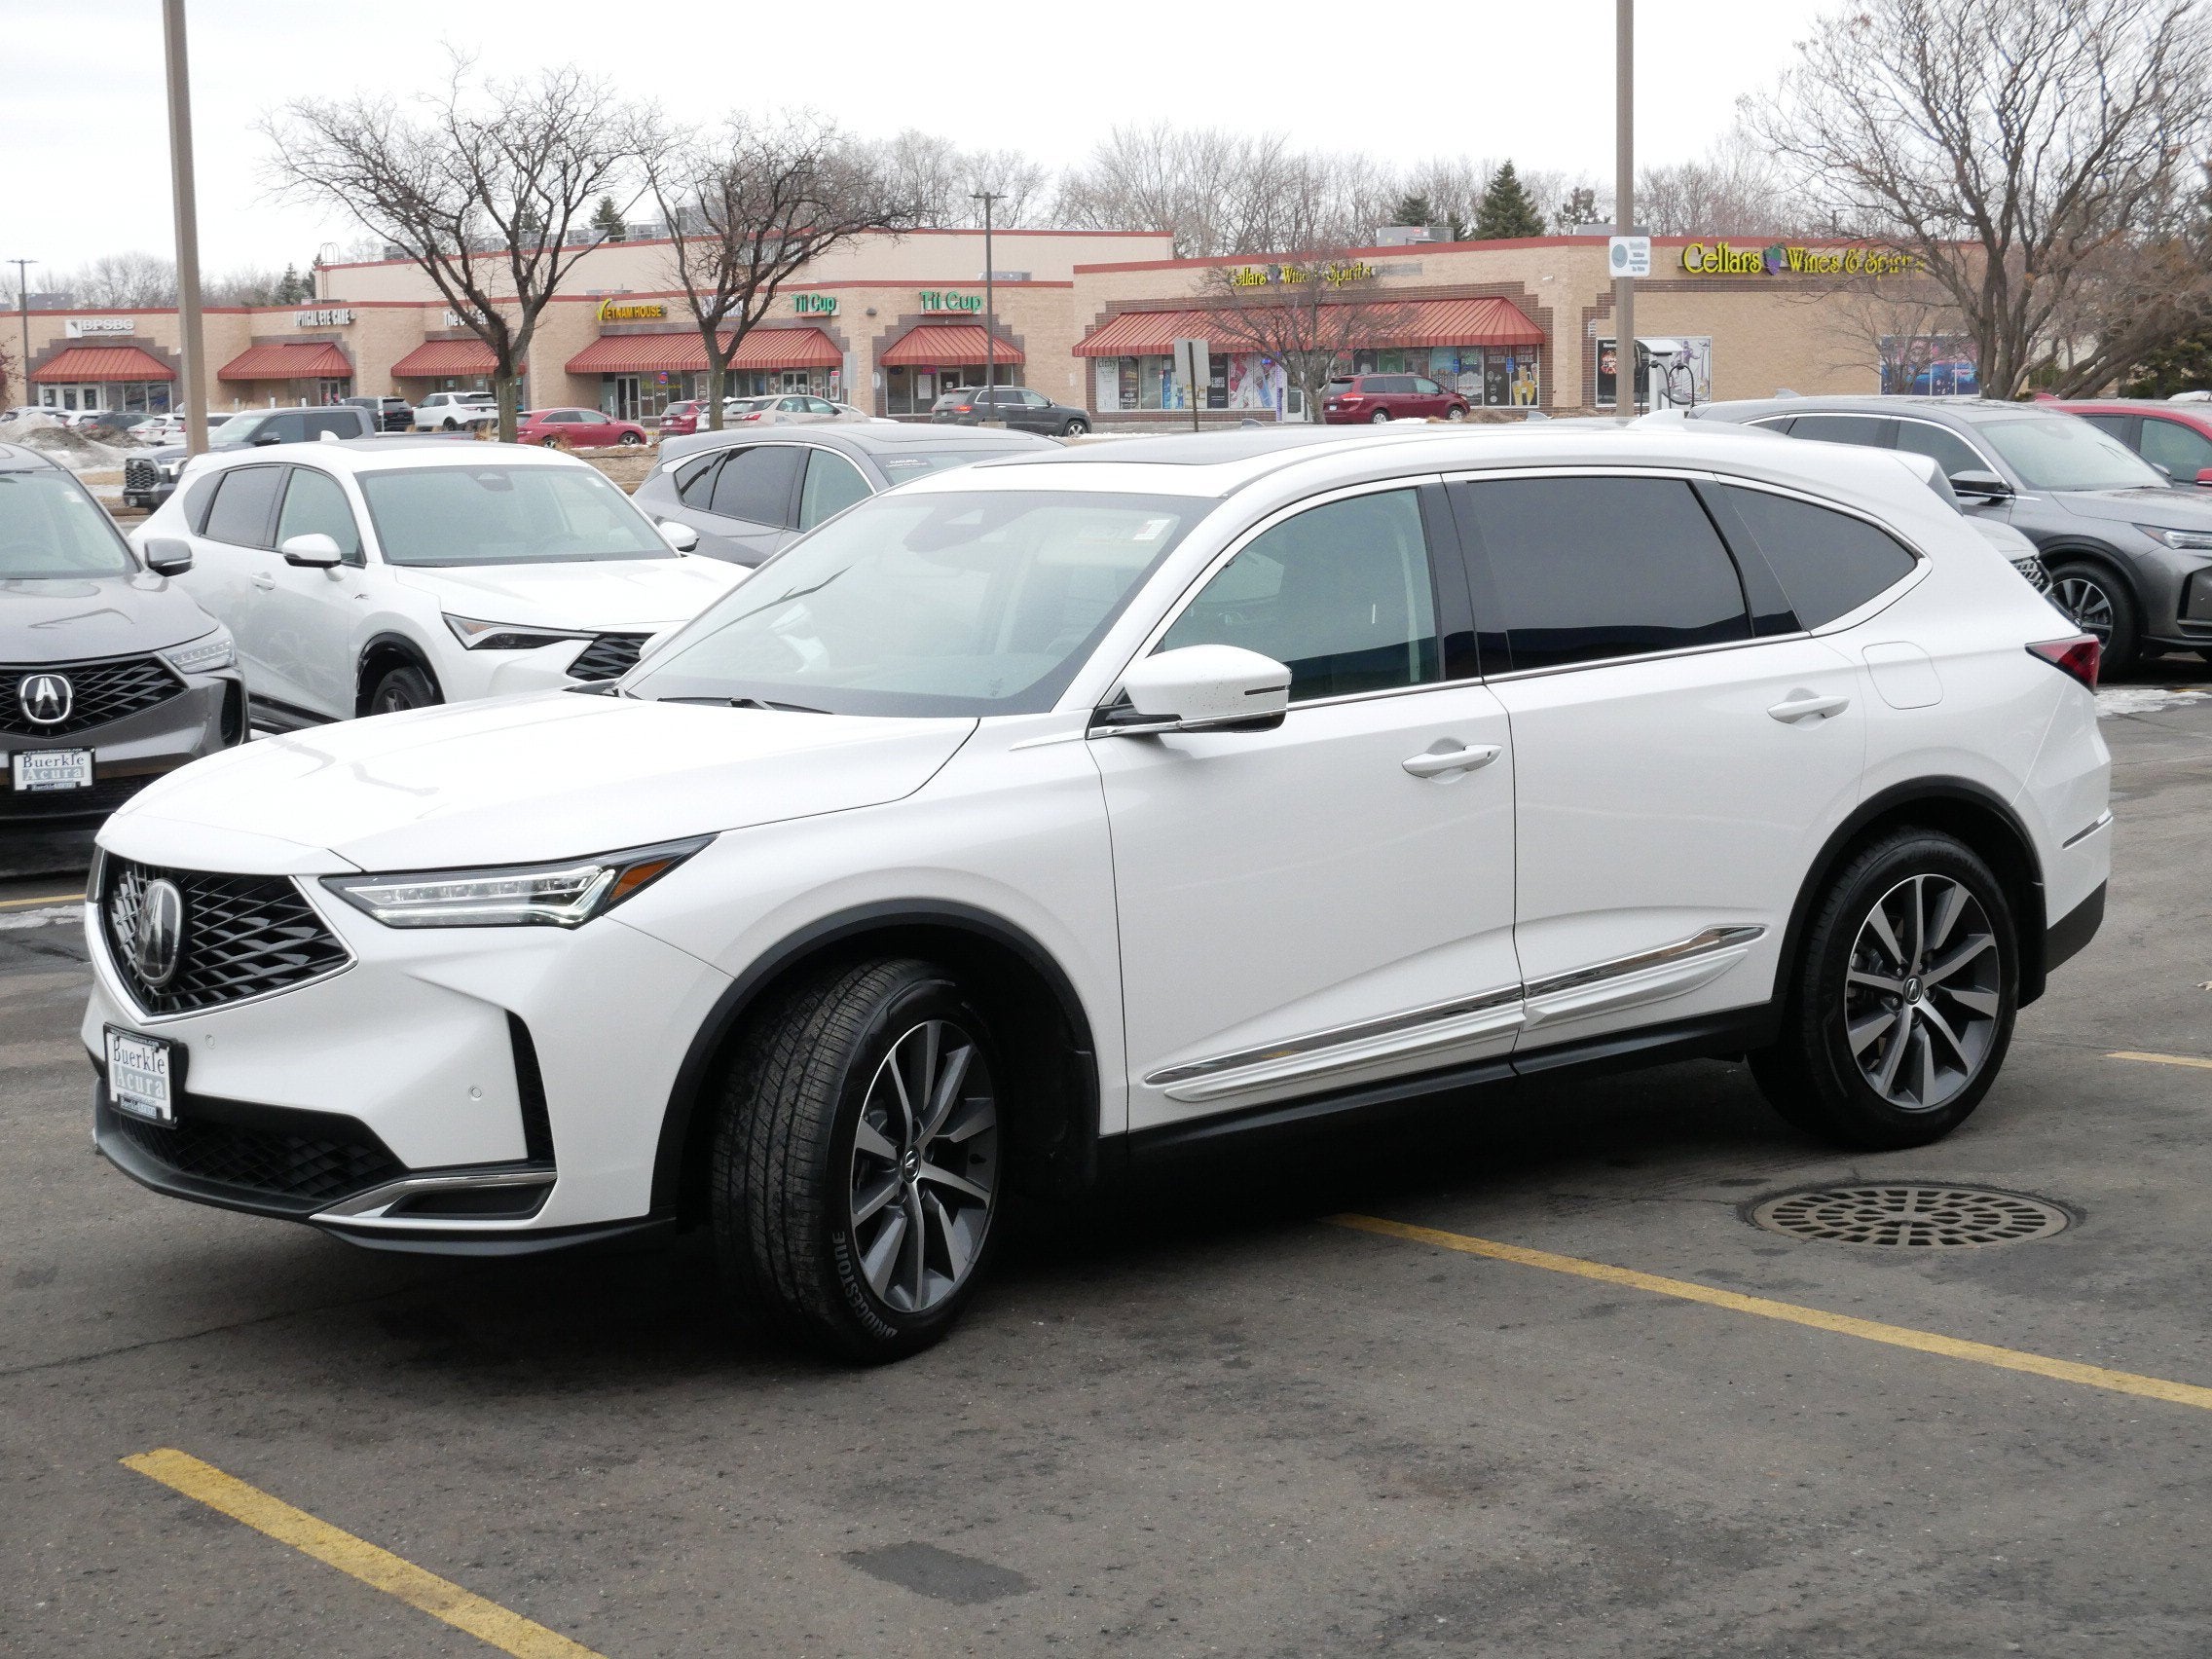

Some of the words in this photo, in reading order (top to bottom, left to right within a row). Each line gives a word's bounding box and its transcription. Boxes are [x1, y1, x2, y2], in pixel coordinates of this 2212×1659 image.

[1682, 241, 1762, 275] Cellars
[1787, 247, 1840, 274] Wines
[1846, 248, 1861, 274] &
[596, 298, 634, 321] VIETNAM
[635, 305, 663, 319] HOUSE
[809, 293, 836, 315] Cup
[946, 291, 983, 313] Cup
[22, 754, 85, 768] Buerkle
[26, 767, 82, 780] Acura
[113, 1037, 166, 1075] Buerkle
[116, 1064, 165, 1100] Acura
[831, 1230, 899, 1340] BRIDGESTONE
